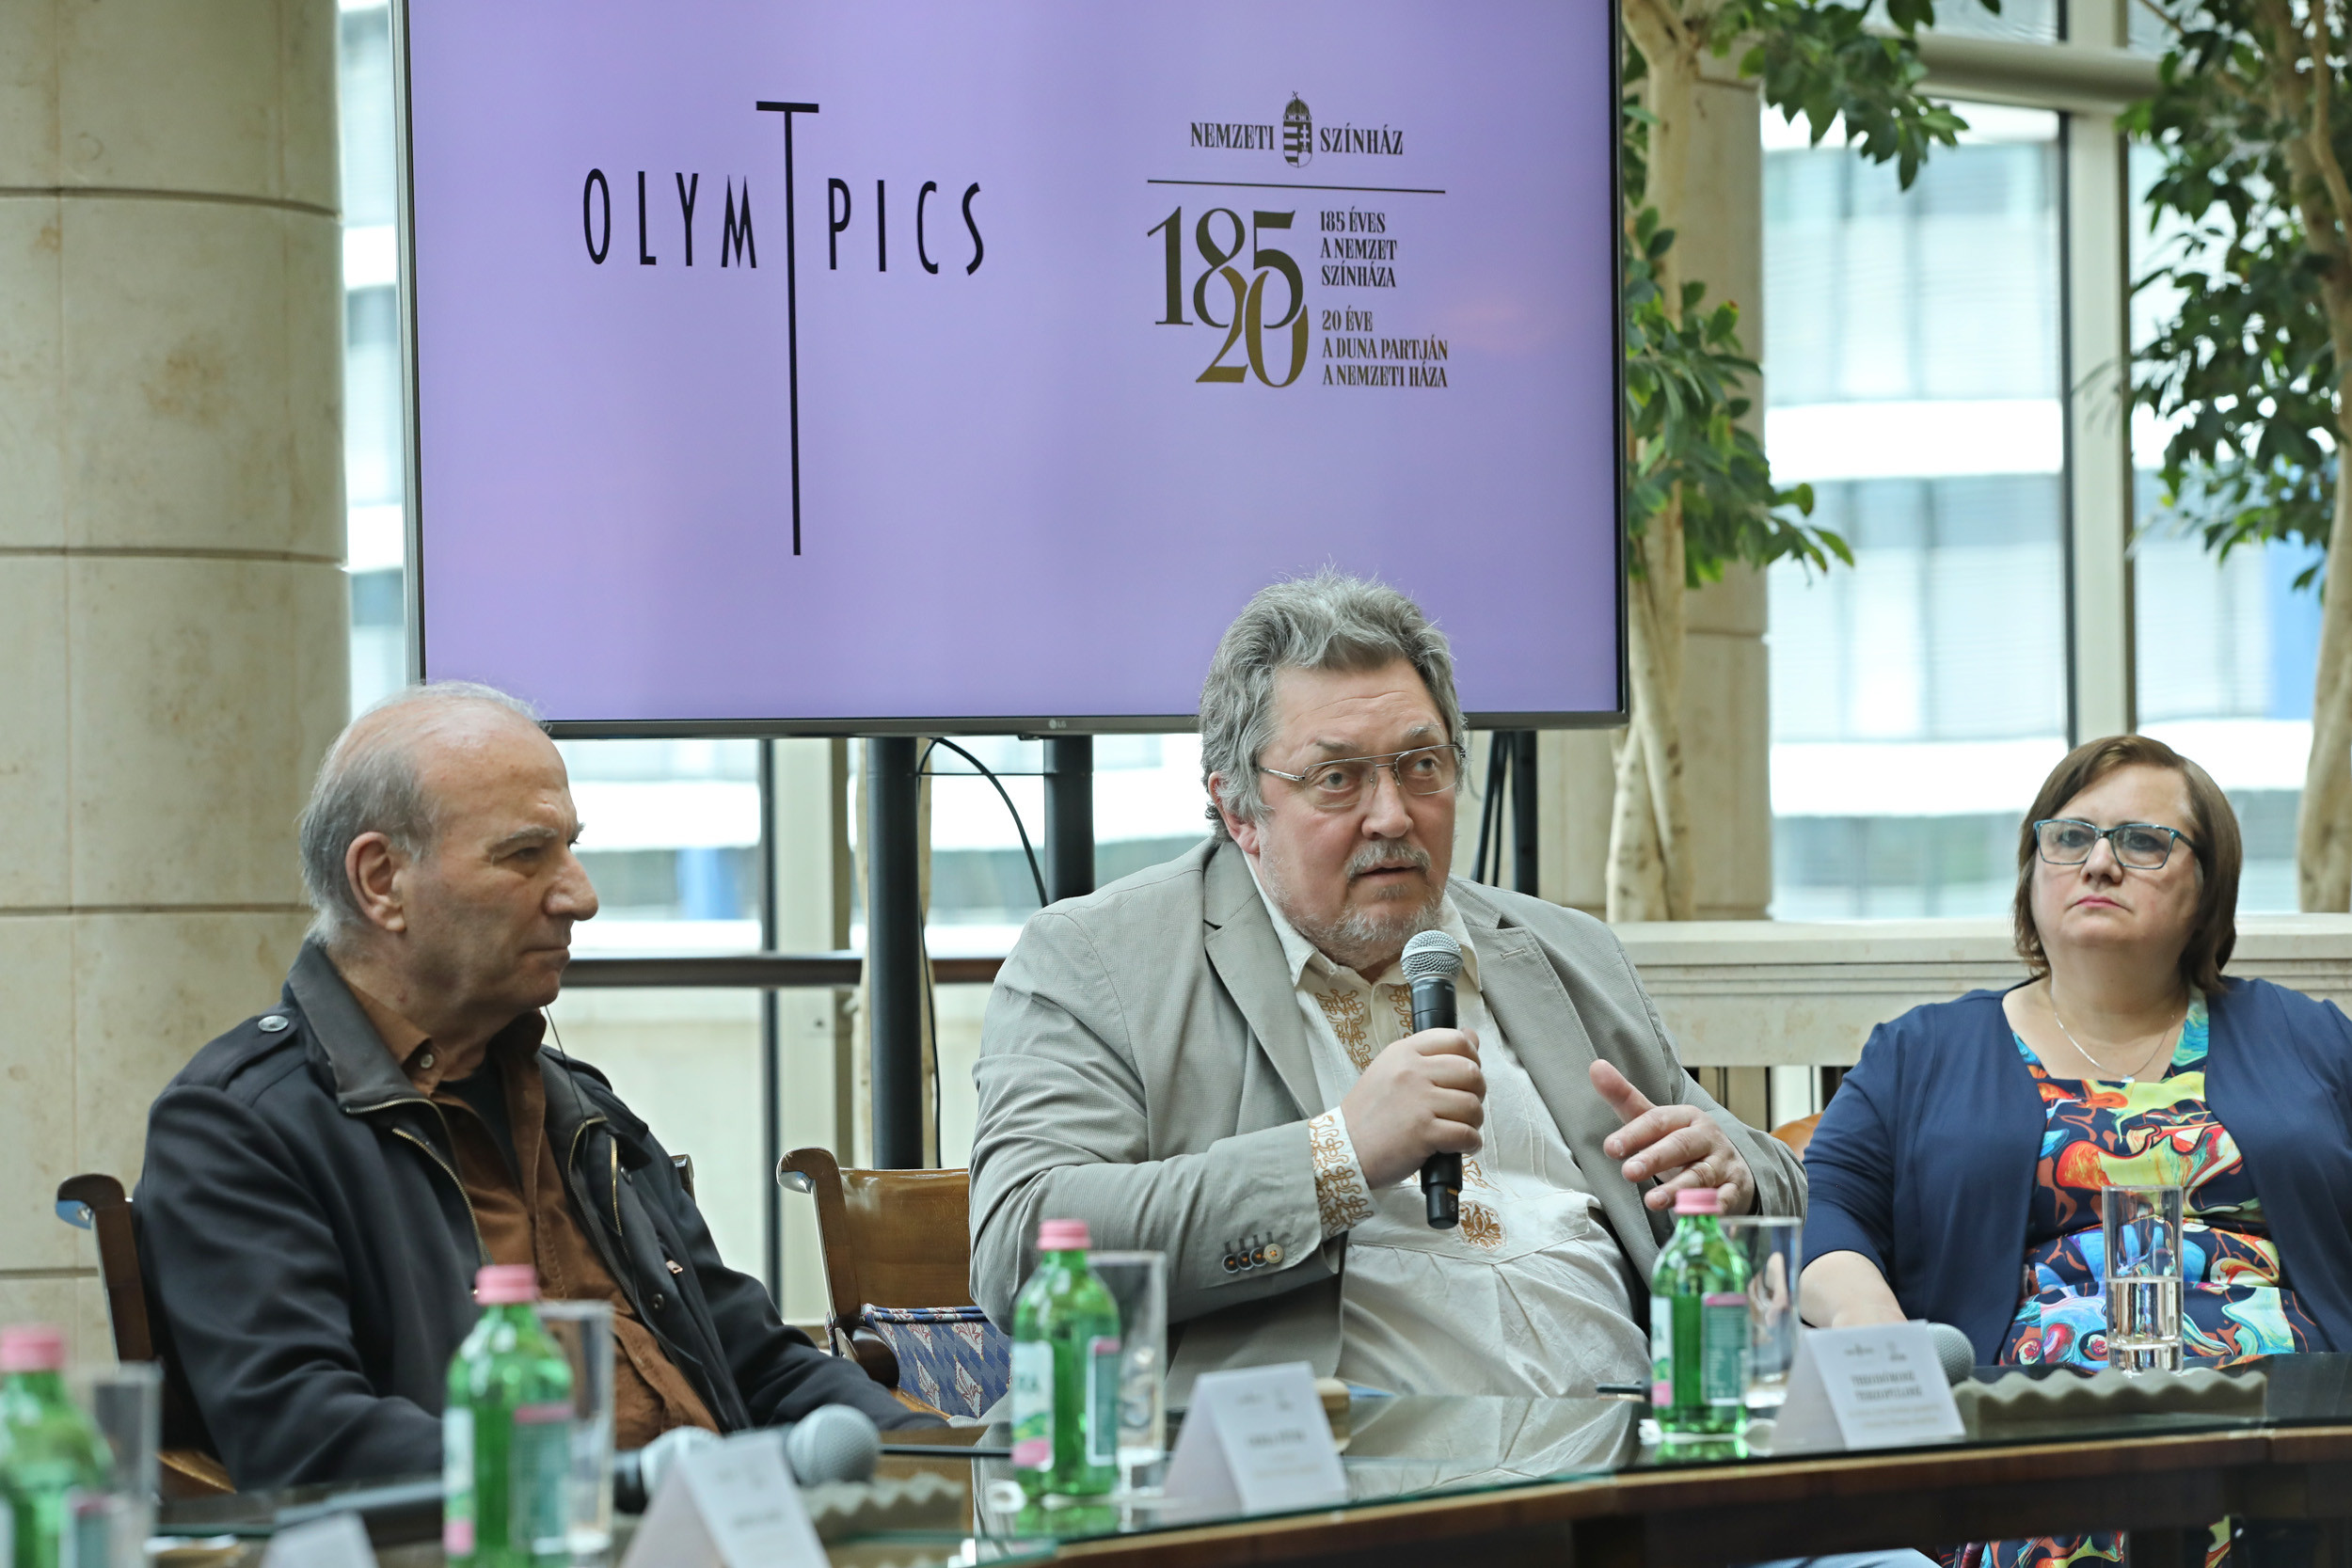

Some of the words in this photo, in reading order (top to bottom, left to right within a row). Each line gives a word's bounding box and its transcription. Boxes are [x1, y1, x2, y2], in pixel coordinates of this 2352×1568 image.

[1190, 121, 1275, 150] NEMZETI
[1320, 122, 1404, 155] SZÍNHÁZ
[1320, 210, 1345, 232] 185
[1348, 206, 1386, 233] ÉVES
[1320, 237, 1331, 259] A
[1334, 238, 1397, 261] NEMZET
[1147, 206, 1304, 329] 185
[1321, 261, 1396, 288] SZÍNHÁZA
[1195, 265, 1309, 388] 20
[1322, 309, 1342, 331] 20
[1345, 305, 1373, 332] ÉVE
[1322, 337, 1333, 358] A
[1336, 338, 1377, 359] DUNA
[1380, 334, 1448, 360] PARTJÁN
[1322, 364, 1333, 386] A
[1336, 364, 1405, 387] NEMZETI
[1408, 360, 1448, 388] HÁZA
